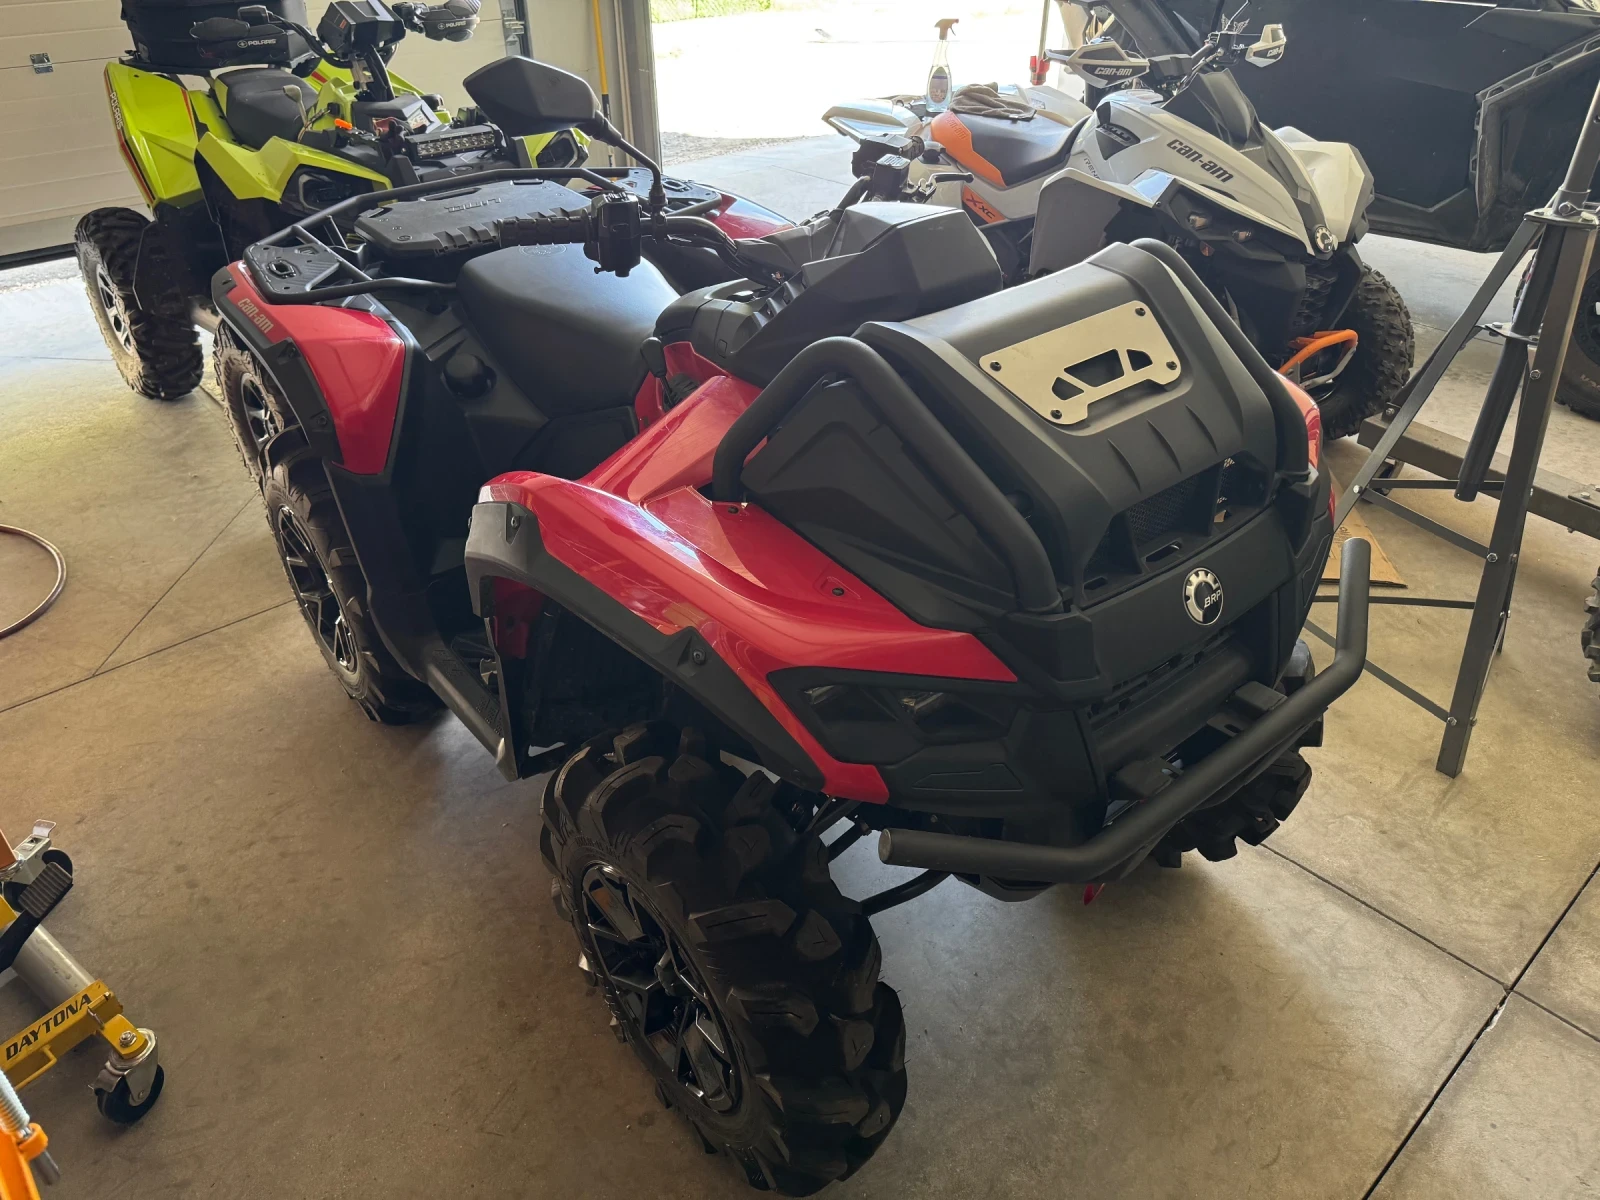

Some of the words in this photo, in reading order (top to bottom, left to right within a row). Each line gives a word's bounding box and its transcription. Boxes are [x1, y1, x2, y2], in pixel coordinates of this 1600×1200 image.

[446, 20, 467, 28] POLARIS
[247, 38, 277, 46] POLARIS
[1094, 66, 1132, 76] can-am
[110, 91, 124, 130] POLARIS
[1166, 138, 1234, 183] can-am
[966, 193, 984, 207] X
[237, 297, 275, 334] can-am
[1203, 589, 1221, 609] BRP
[5, 993, 92, 1061] DAYTONA
